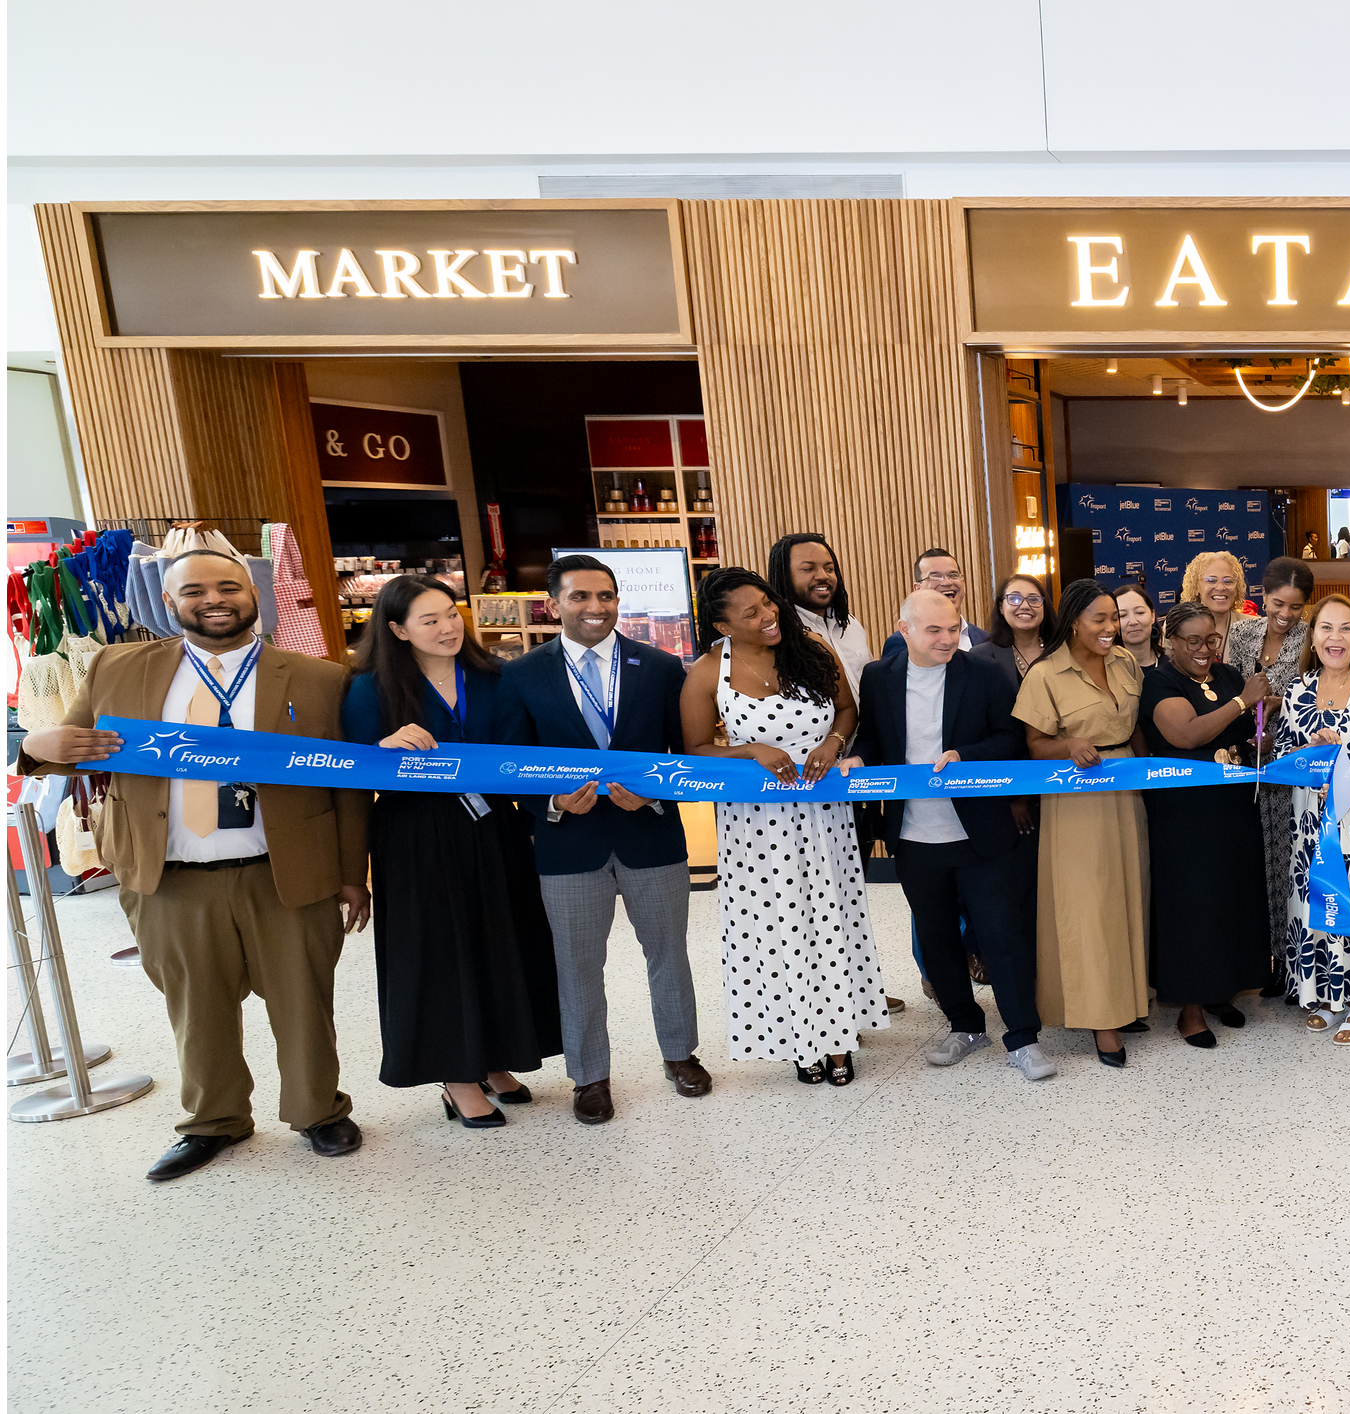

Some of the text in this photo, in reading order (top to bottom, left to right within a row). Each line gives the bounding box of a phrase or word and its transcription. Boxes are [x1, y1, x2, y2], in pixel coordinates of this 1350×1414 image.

[252, 248, 576, 298] MARKET
[326, 429, 411, 461] & GO
[1119, 500, 1140, 511] jetBlue
[1154, 532, 1174, 543] jetBlue
[1094, 565, 1115, 576] jetBlue
[619, 580, 675, 592] Favorites
[179, 751, 241, 767] Fraport
[286, 752, 355, 769] jetBlue
[1309, 759, 1329, 767] John
[556, 766, 603, 775] Kennedy
[1146, 766, 1192, 781] jetBlue
[677, 777, 725, 791] Fraport
[944, 778, 966, 786] John
[1076, 776, 1115, 786] Fraport
[1322, 893, 1339, 927] jetBlue
